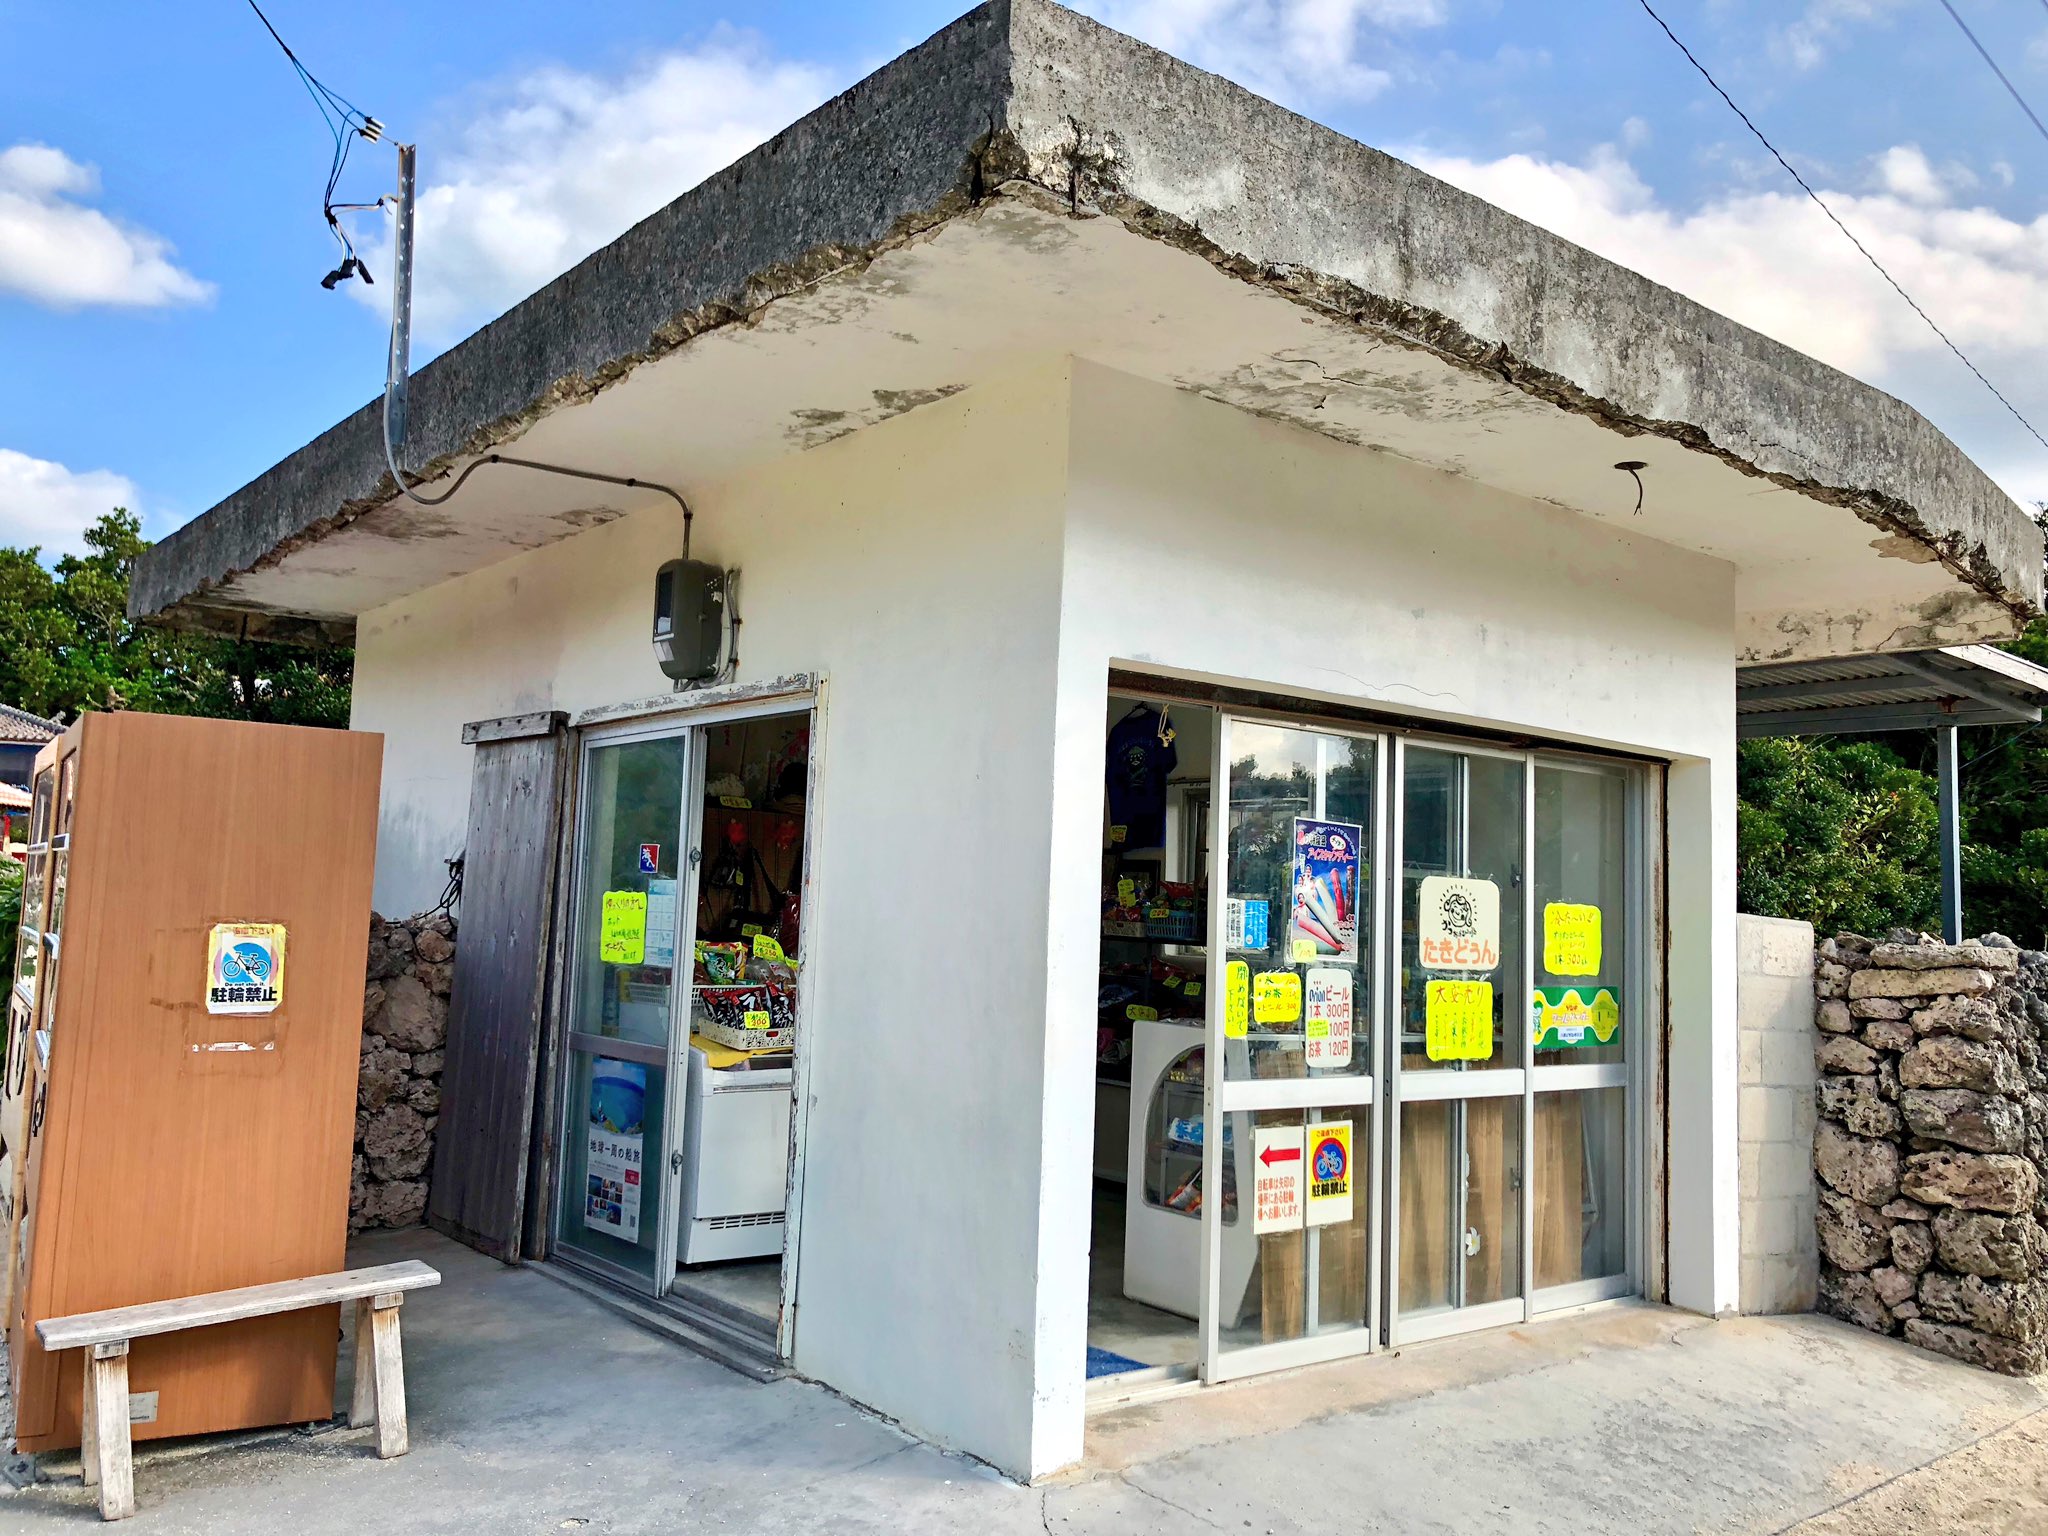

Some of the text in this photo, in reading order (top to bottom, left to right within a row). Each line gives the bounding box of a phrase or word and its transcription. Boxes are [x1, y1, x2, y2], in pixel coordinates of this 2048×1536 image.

[210, 987, 278, 1003] 駐輪禁止
[1326, 1003, 1350, 1018] 300円
[1329, 1021, 1350, 1037] 100円
[1308, 1040, 1349, 1058] お茶 120円
[590, 1138, 641, 1164] 地球一周の船旅
[1257, 1175, 1295, 1192] 自転車は矢印の
[1312, 1180, 1347, 1198] 駐輪禁止
